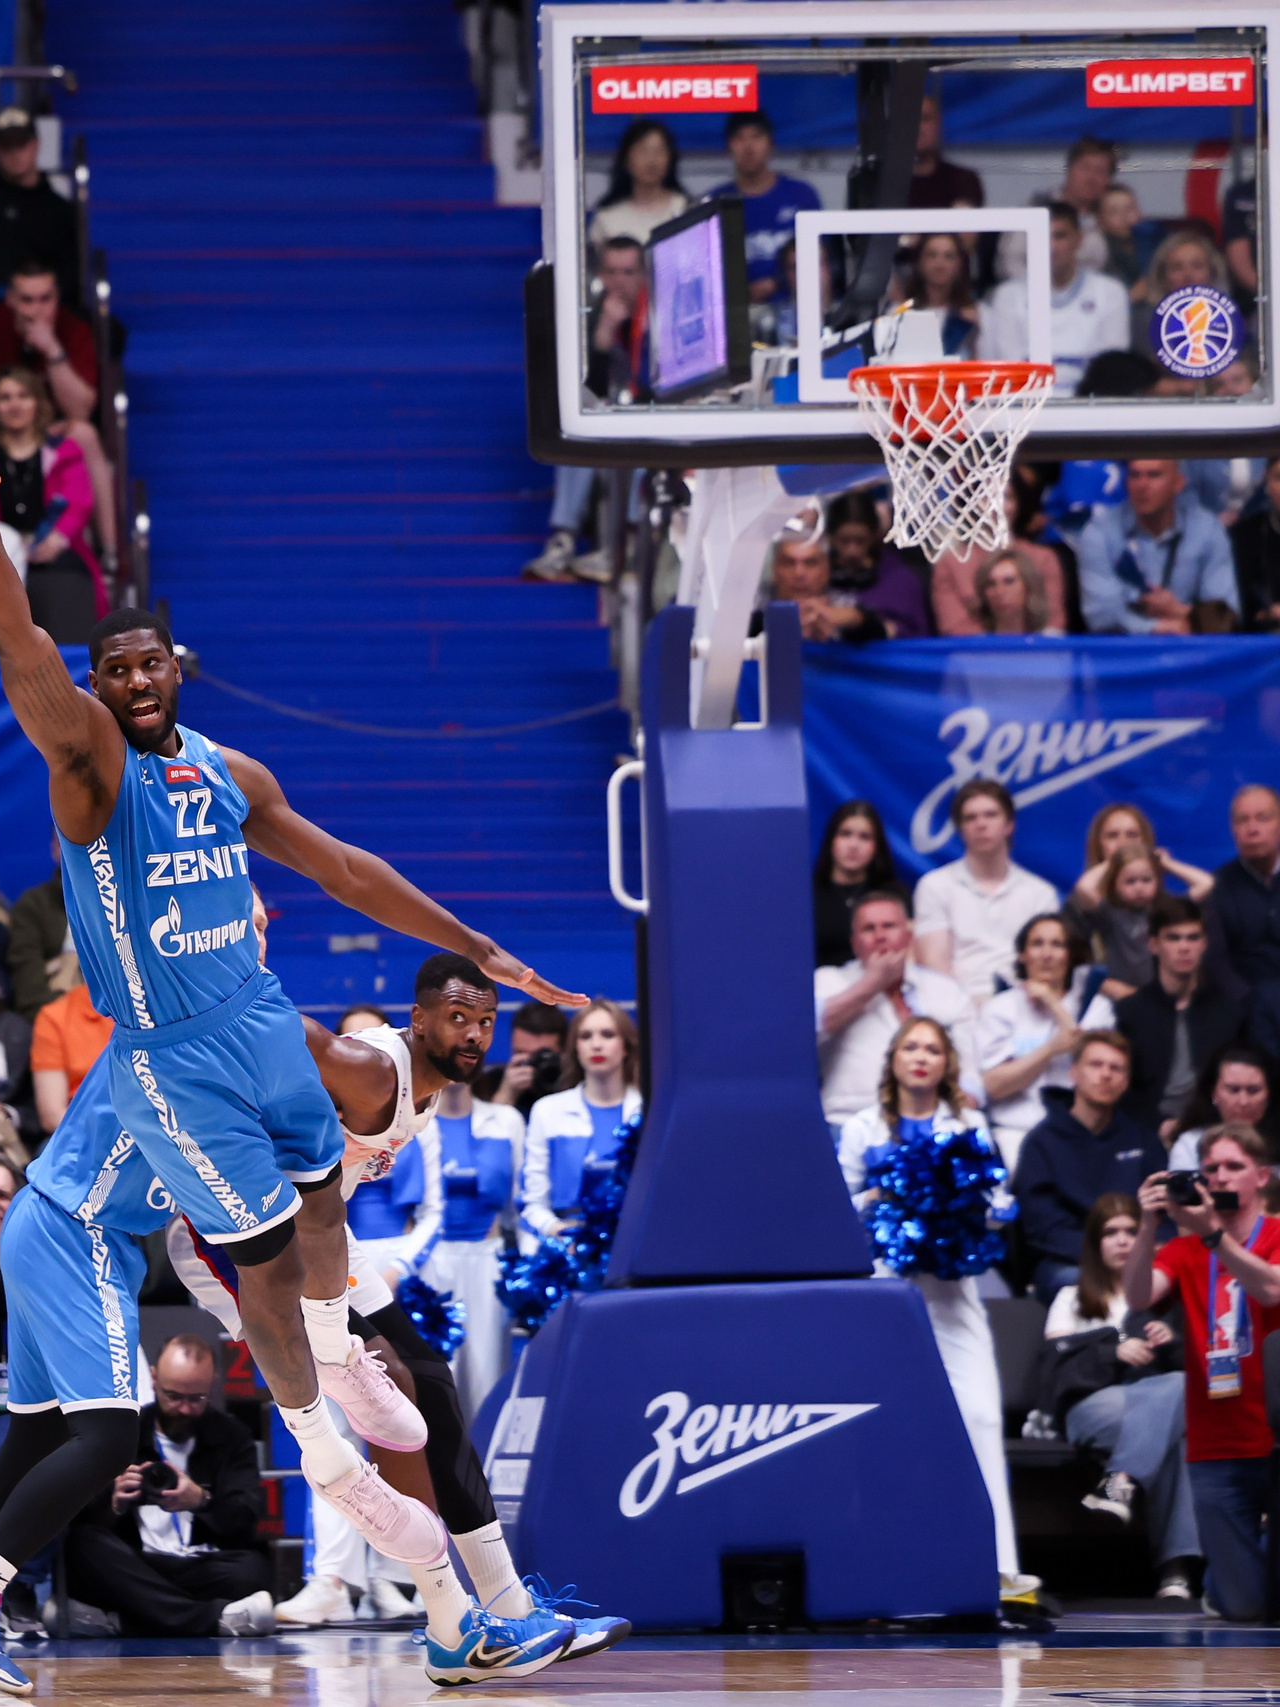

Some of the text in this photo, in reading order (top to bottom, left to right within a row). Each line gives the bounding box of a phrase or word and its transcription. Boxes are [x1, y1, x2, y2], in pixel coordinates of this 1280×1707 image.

[597, 78, 750, 99] OLIMPBET
[1092, 72, 1246, 93] OLIMPBET
[167, 787, 217, 838] 22
[145, 842, 248, 888] ZENIT
[185, 919, 248, 955] ГАЗПРОМ
[618, 1390, 882, 1518] Зенит
